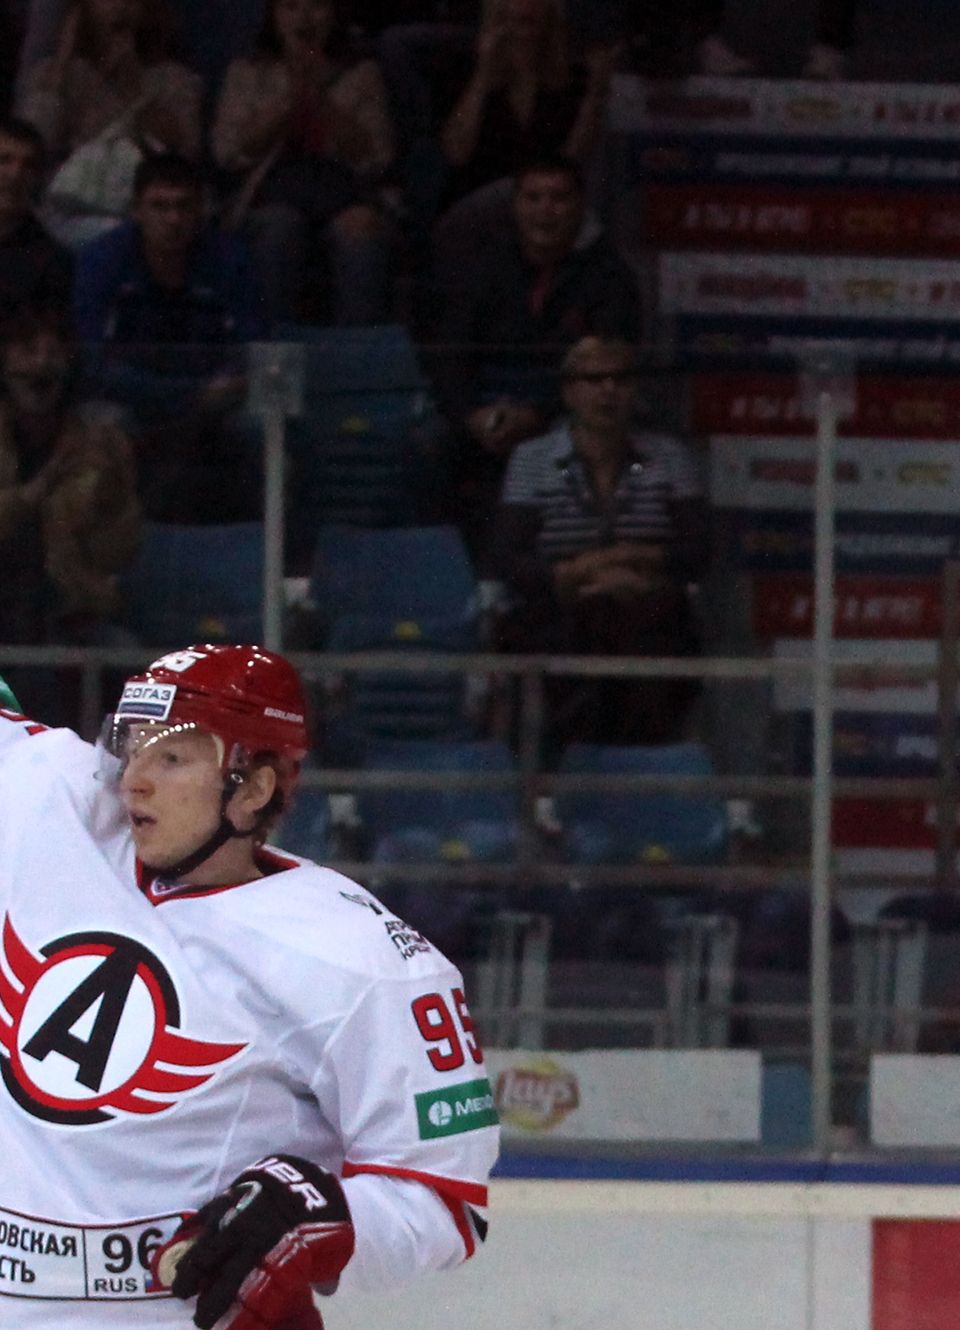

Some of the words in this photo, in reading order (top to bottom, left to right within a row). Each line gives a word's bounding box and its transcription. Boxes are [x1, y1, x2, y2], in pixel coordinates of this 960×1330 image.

[123, 687, 172, 702] СОГАЗ
[101, 1227, 164, 1274] 96
[93, 1277, 138, 1293] RUS
